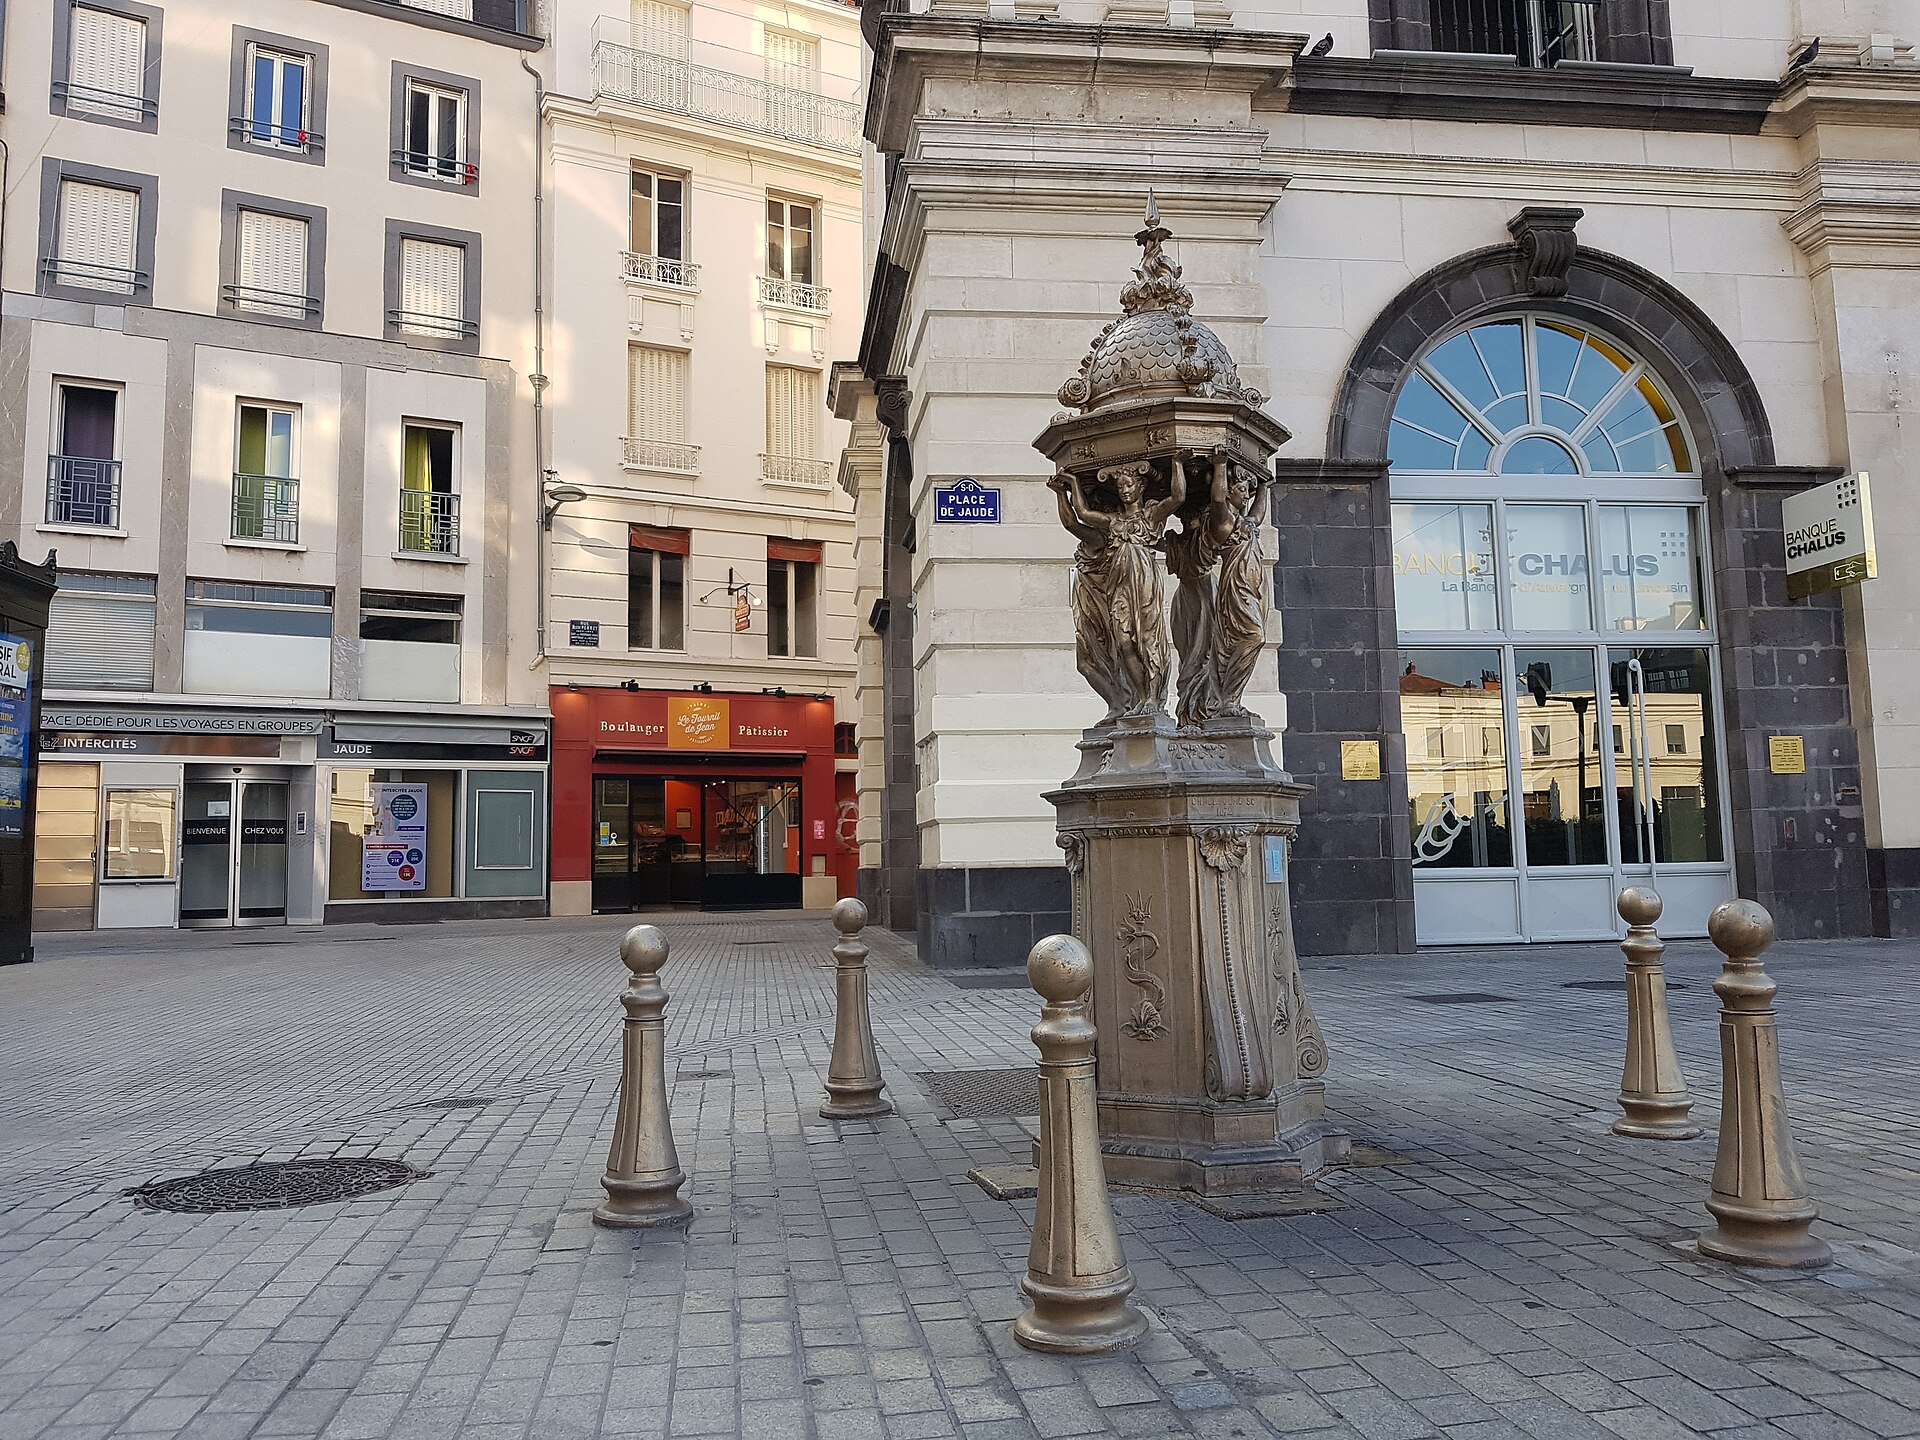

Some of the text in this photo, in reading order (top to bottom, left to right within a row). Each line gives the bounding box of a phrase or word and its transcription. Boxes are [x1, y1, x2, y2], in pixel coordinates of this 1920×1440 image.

[948, 495, 986, 505] PLACE
[940, 507, 995, 517] DE JAUDE
[1786, 518, 1838, 546] BANQUE
[1786, 531, 1846, 559] CHALUS
[1442, 581, 1458, 593] La
[76, 714, 114, 727] DÉDIÉ
[116, 717, 152, 728] POUR
[155, 718, 178, 728] LES
[180, 719, 235, 730] VOYAGES
[238, 720, 255, 730] EN
[257, 721, 314, 731] GROUPES
[677, 711, 721, 727] Le Fournil
[600, 720, 665, 736] Boulanger
[685, 722, 716, 735] de Jean
[738, 725, 789, 737] Pâtissier
[63, 737, 138, 750] INTERCITÉS
[511, 735, 534, 743] SNCF
[333, 744, 373, 755] JAUDE
[509, 746, 535, 755] SNCF
[186, 827, 284, 835] BIENVENUE CHEZ VOUS
